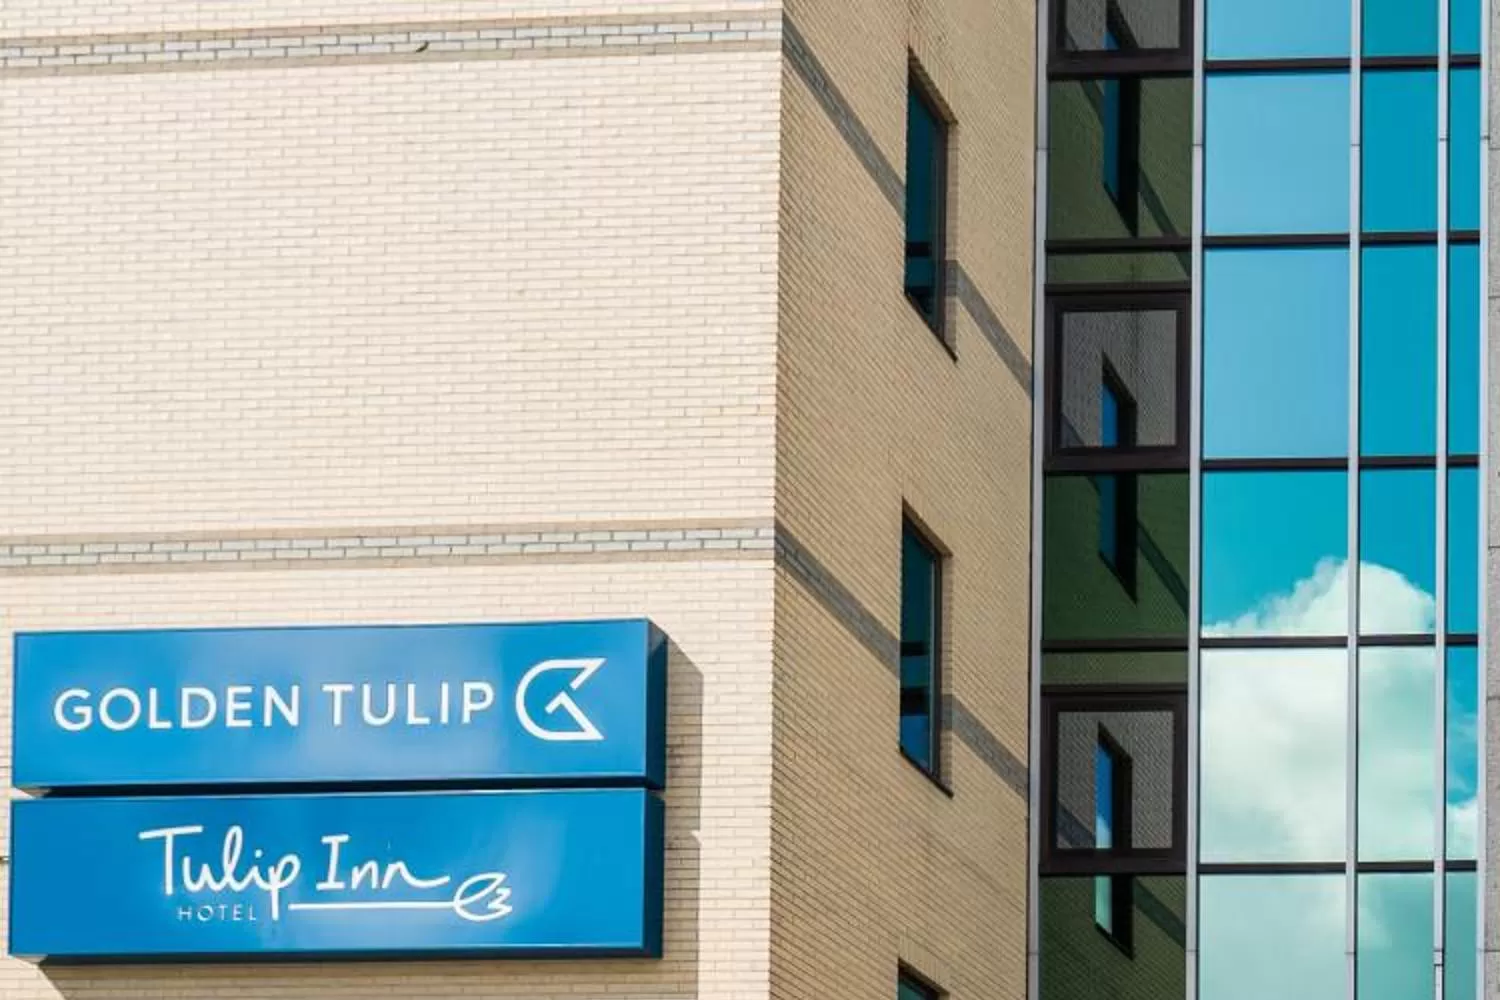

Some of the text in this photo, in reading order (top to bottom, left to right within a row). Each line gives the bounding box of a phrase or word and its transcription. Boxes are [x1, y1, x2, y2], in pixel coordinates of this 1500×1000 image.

[53, 681, 495, 731] GOLDEN TULIP
[139, 825, 451, 920] Tulip Inn
[178, 904, 257, 922] HOTEL
